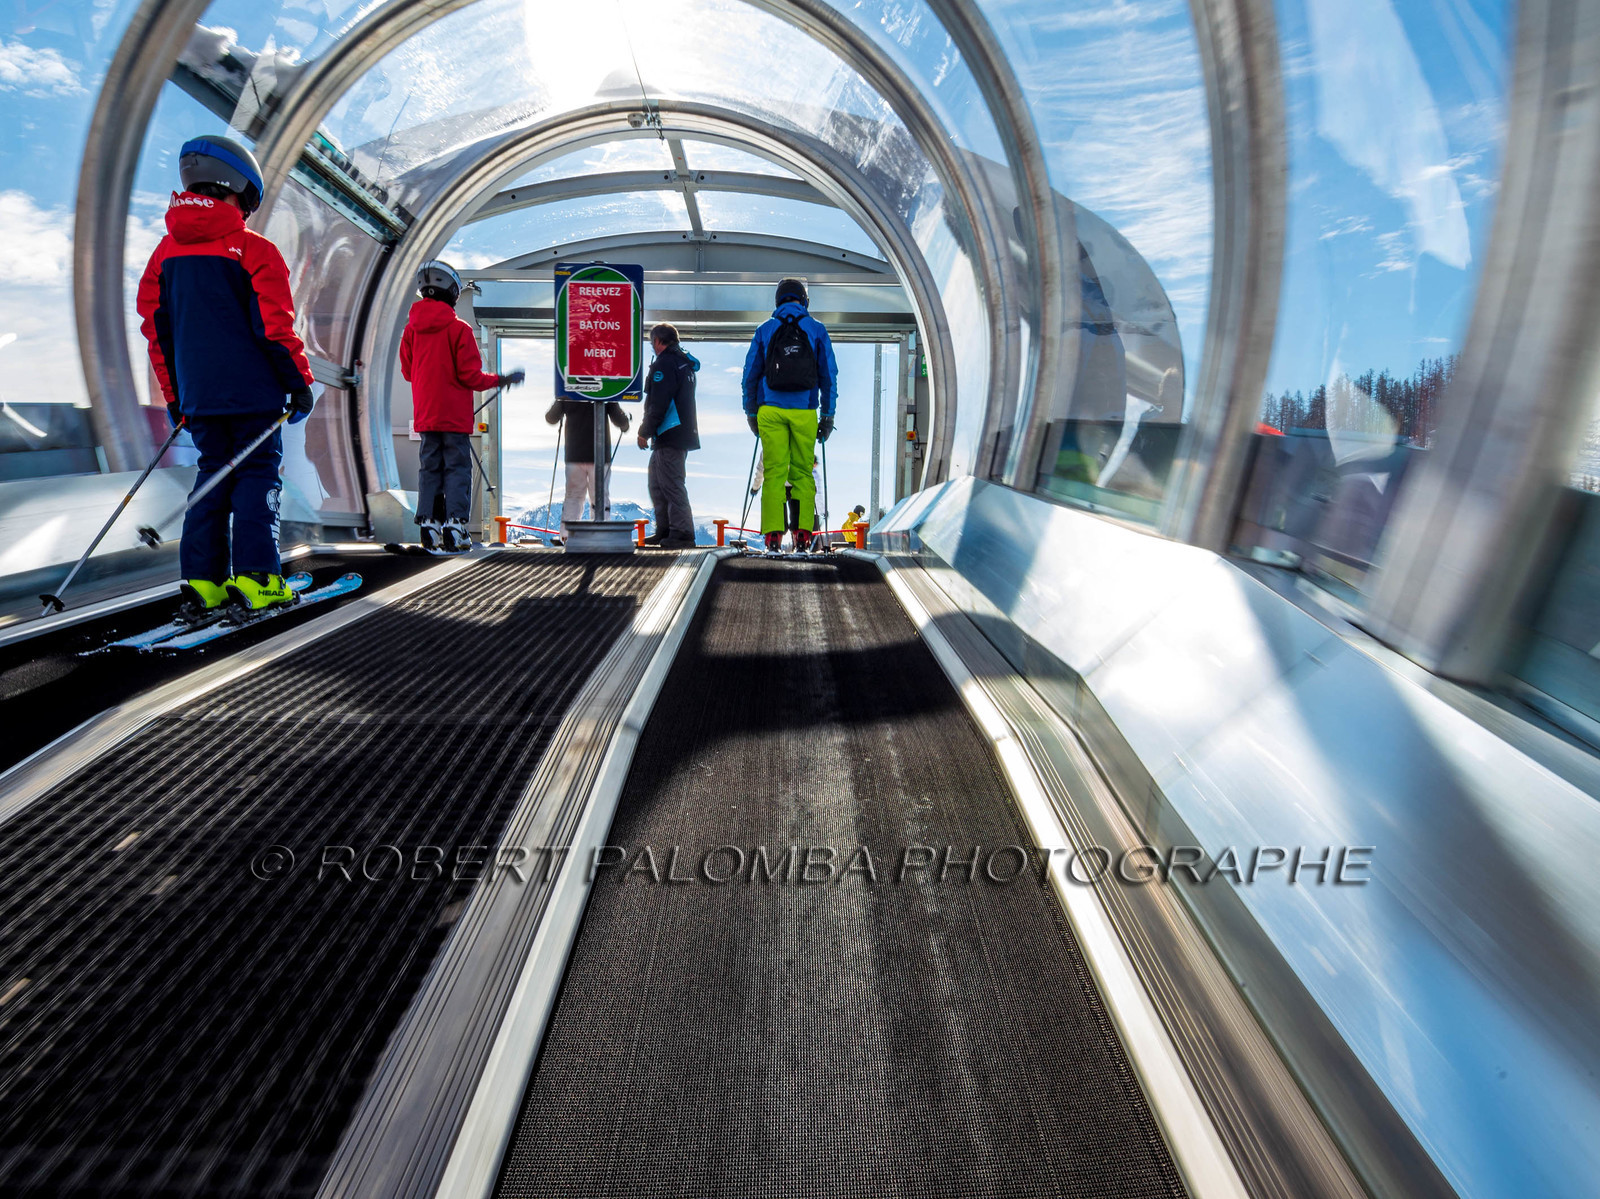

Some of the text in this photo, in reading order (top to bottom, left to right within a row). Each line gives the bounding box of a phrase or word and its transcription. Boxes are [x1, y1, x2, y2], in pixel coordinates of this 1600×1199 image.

[579, 286, 621, 296] RELEVEZ
[589, 303, 611, 313] VOS
[579, 320, 621, 331] BATONS
[583, 348, 616, 358] MERCI
